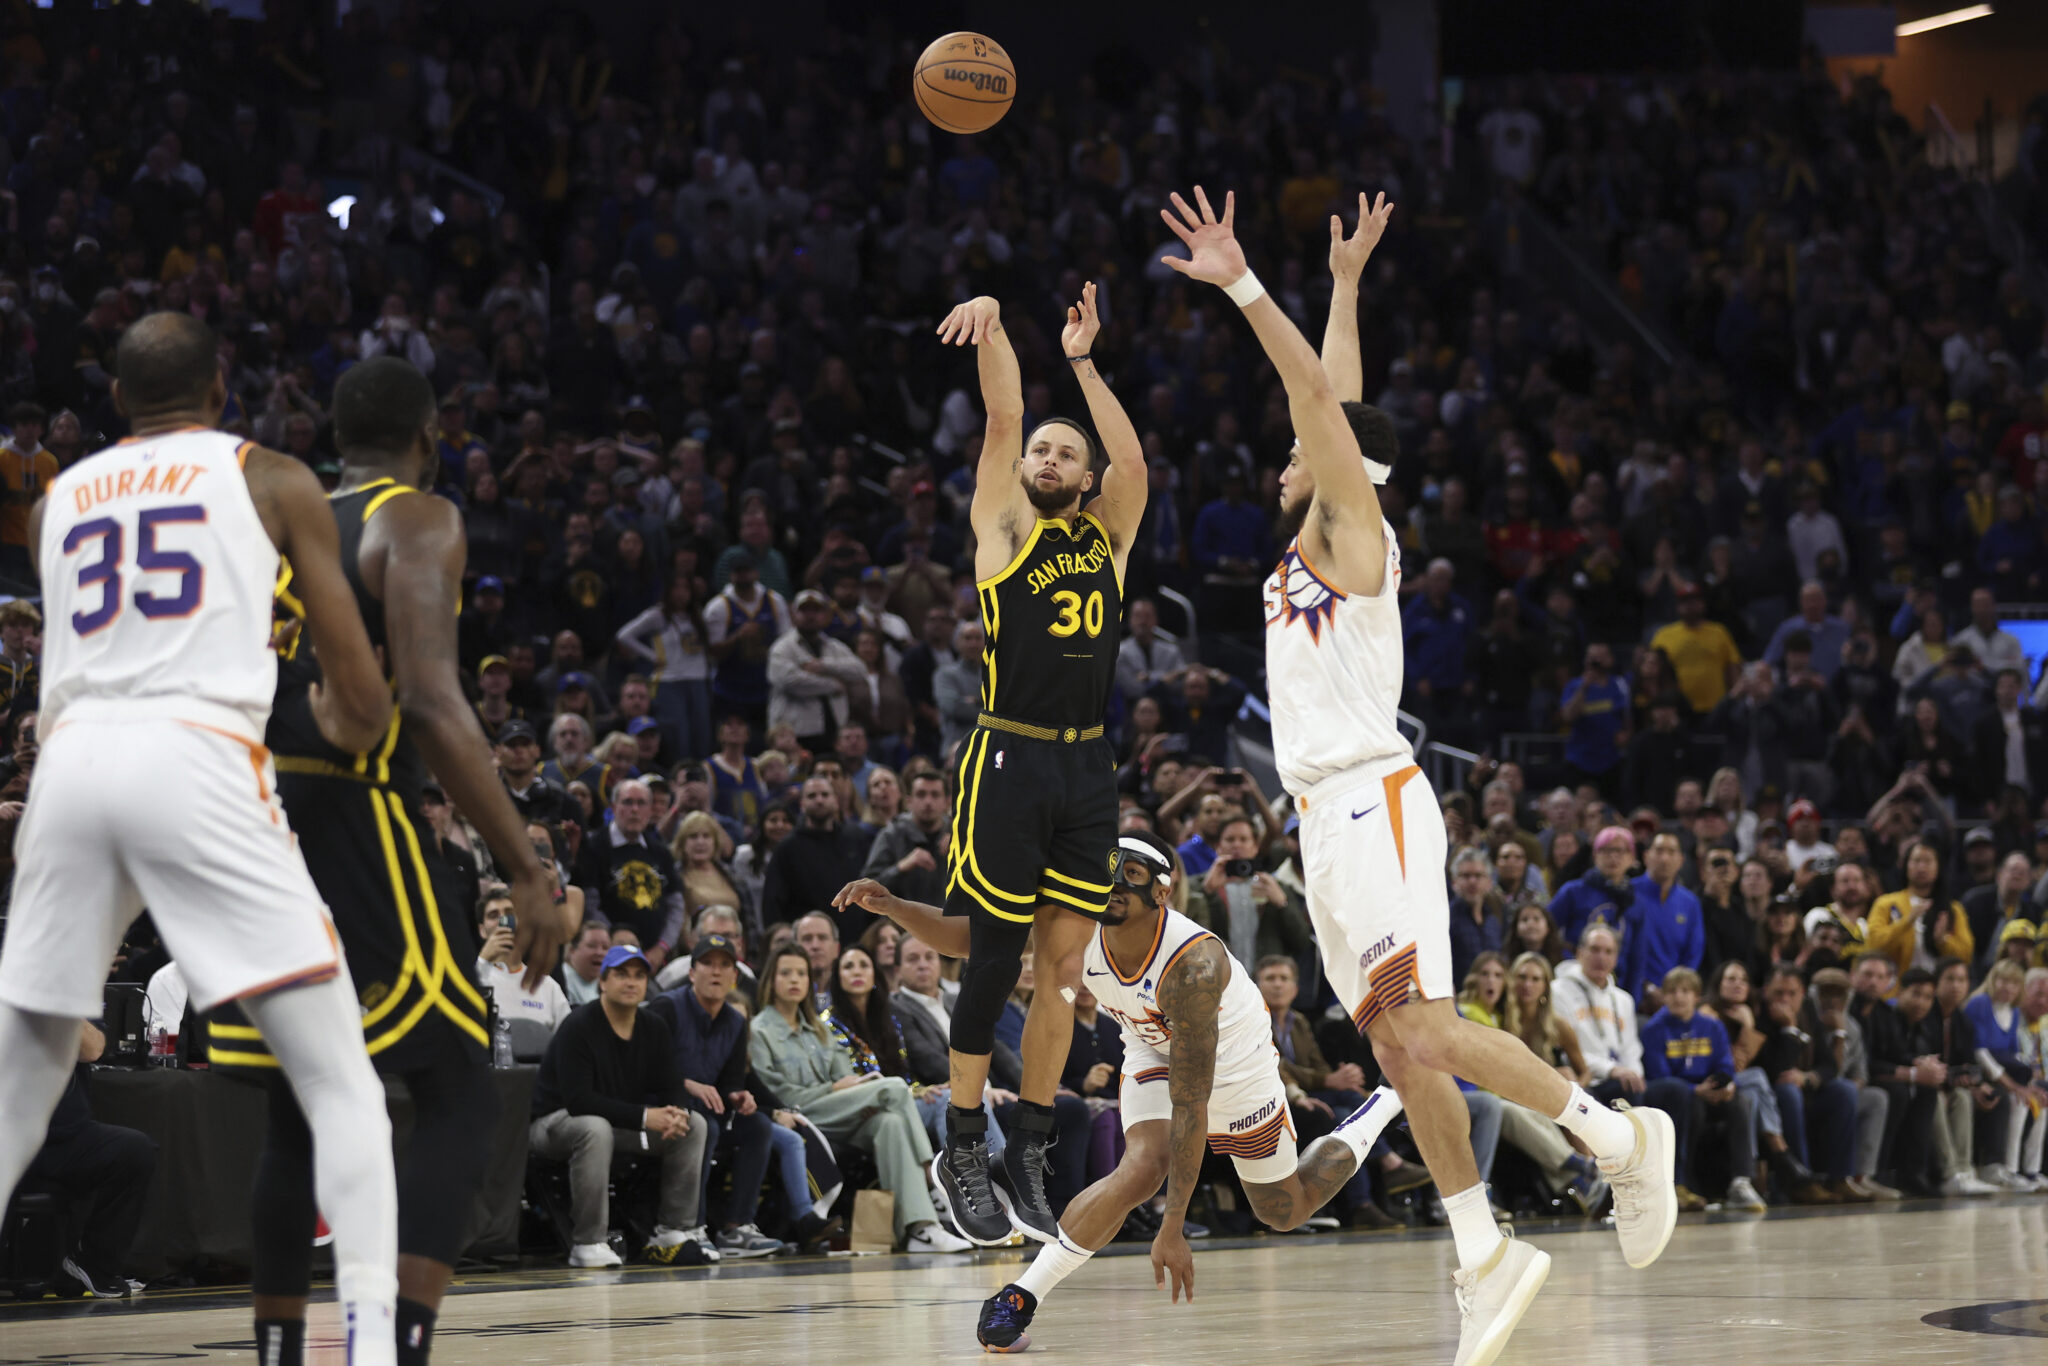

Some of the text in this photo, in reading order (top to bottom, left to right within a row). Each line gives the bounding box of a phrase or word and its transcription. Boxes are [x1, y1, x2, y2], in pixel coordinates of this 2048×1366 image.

[944, 68, 1007, 95] Wilson
[74, 464, 207, 515] DURANT
[63, 504, 207, 639] 35
[1027, 538, 1108, 595] SAN FRACISCO
[1047, 590, 1104, 639] 30
[1359, 931, 1396, 969] OENIX
[1229, 1097, 1276, 1132] PHOENIX
